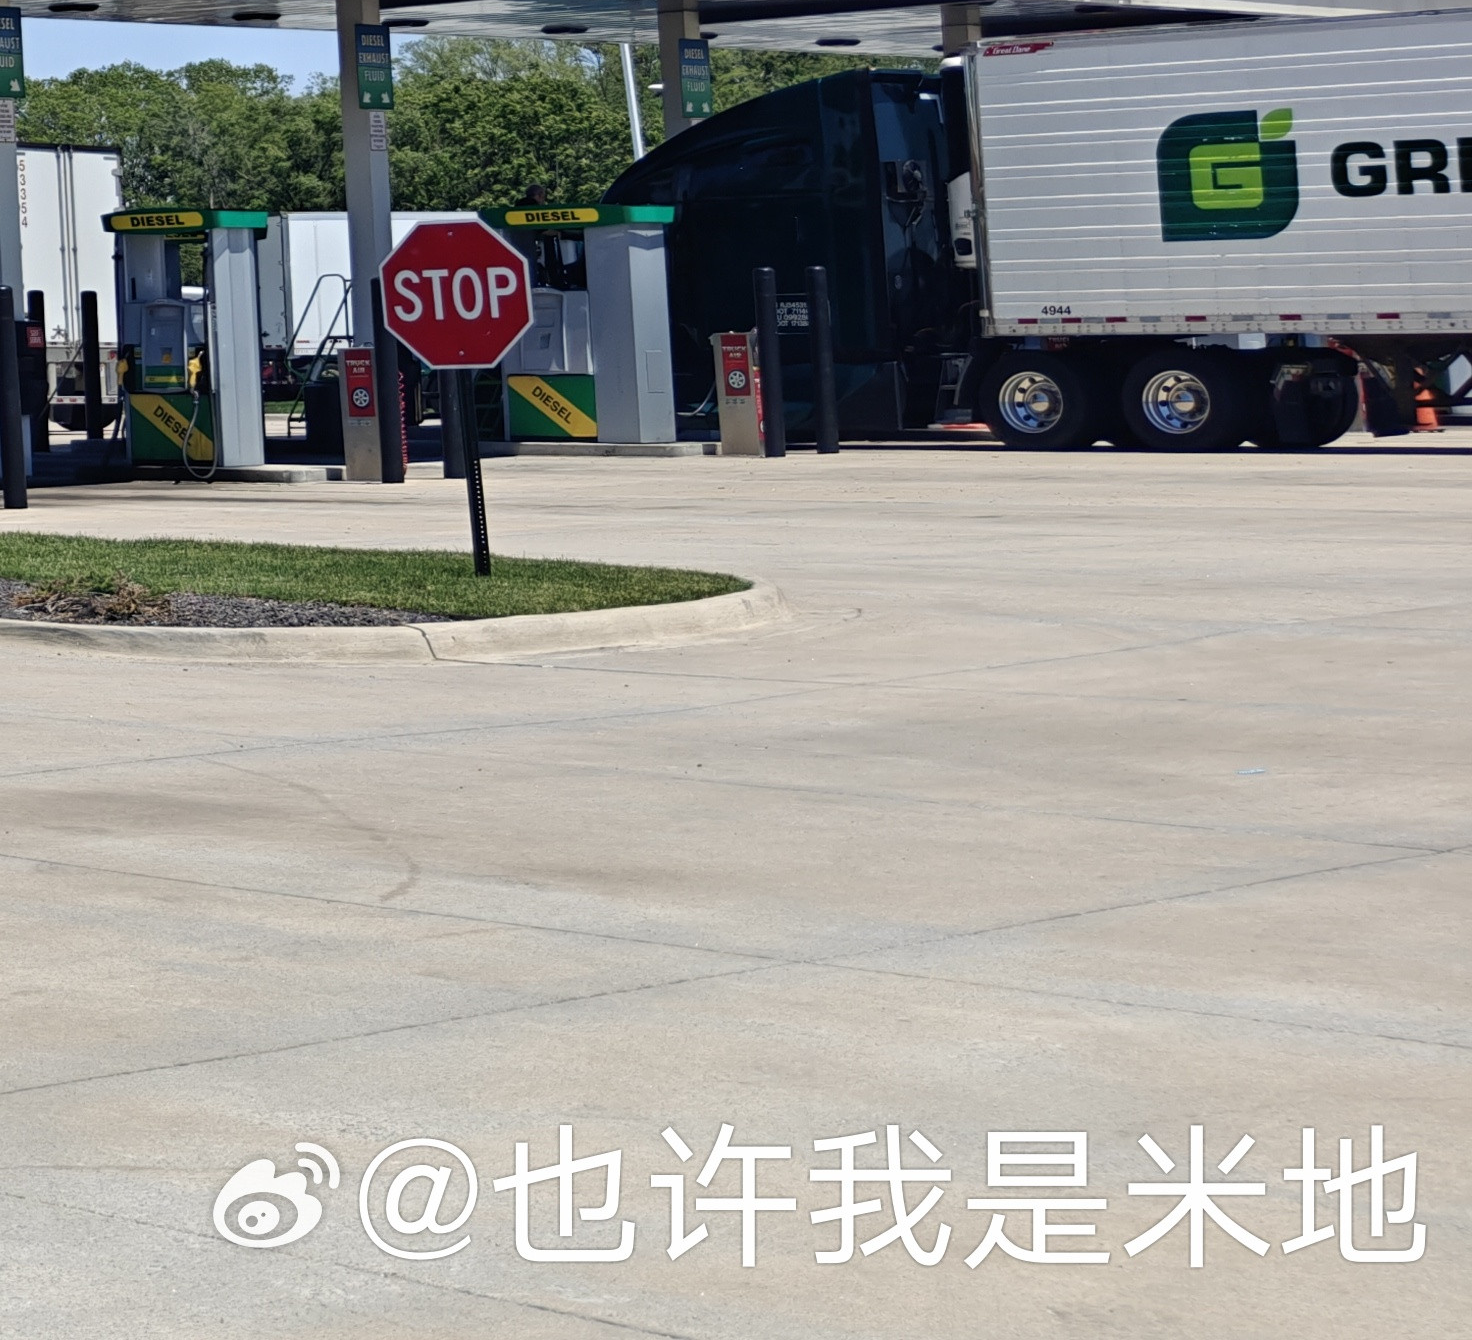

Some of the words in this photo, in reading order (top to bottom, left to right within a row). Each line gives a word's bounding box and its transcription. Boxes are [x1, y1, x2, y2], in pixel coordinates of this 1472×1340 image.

[361, 34, 385, 46] DIESEL
[358, 52, 389, 64] EXHAUST
[364, 70, 385, 81] FLUID
[130, 214, 186, 228] DIESEL
[524, 211, 580, 223] DIESEL
[393, 266, 518, 323] STOP
[1041, 305, 1072, 316] 4944
[532, 385, 572, 424] DIESEL
[153, 405, 193, 447] DIESEL
